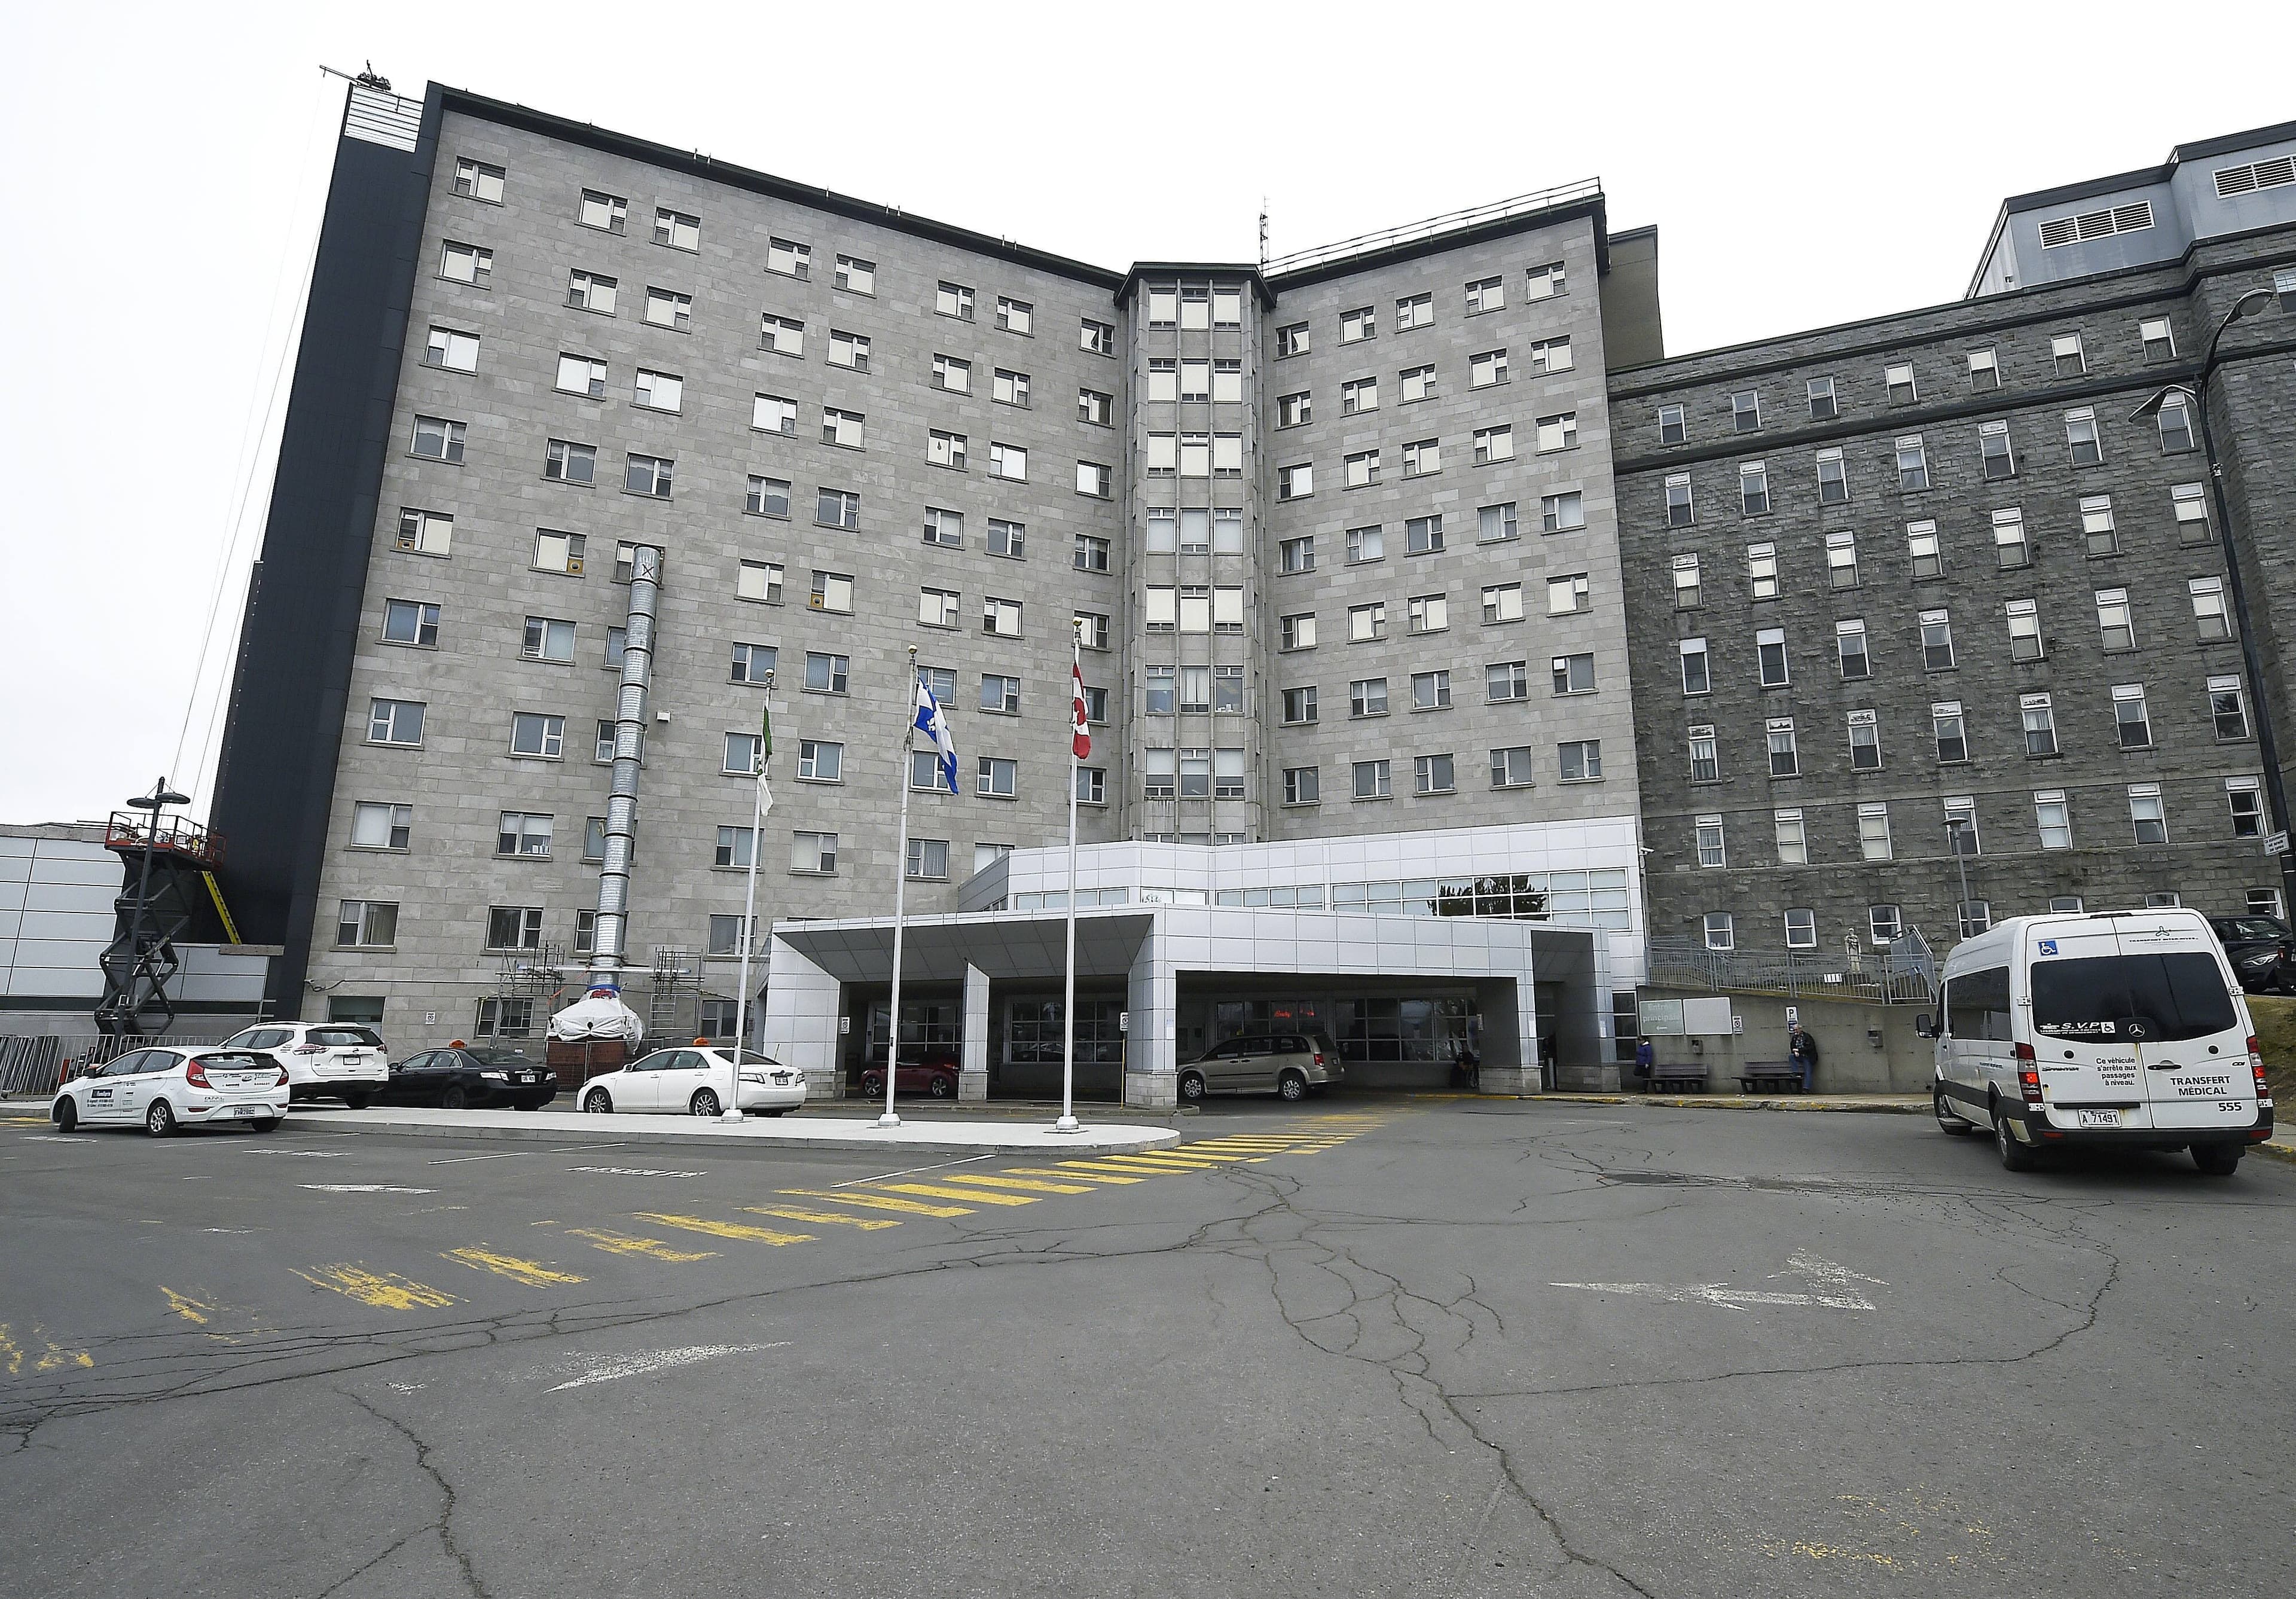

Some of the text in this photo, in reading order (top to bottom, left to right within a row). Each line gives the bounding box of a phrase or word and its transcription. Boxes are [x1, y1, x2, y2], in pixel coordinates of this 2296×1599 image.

[1789, 1009, 1794, 1017] P
[1642, 1014, 1681, 1023] principal
[2170, 1076, 2230, 1085] TRANSFERT
[2178, 1086, 2227, 1096] MÉDICAL
[2218, 1102, 2242, 1112] 555
[2083, 1114, 2117, 1123] A 71491
